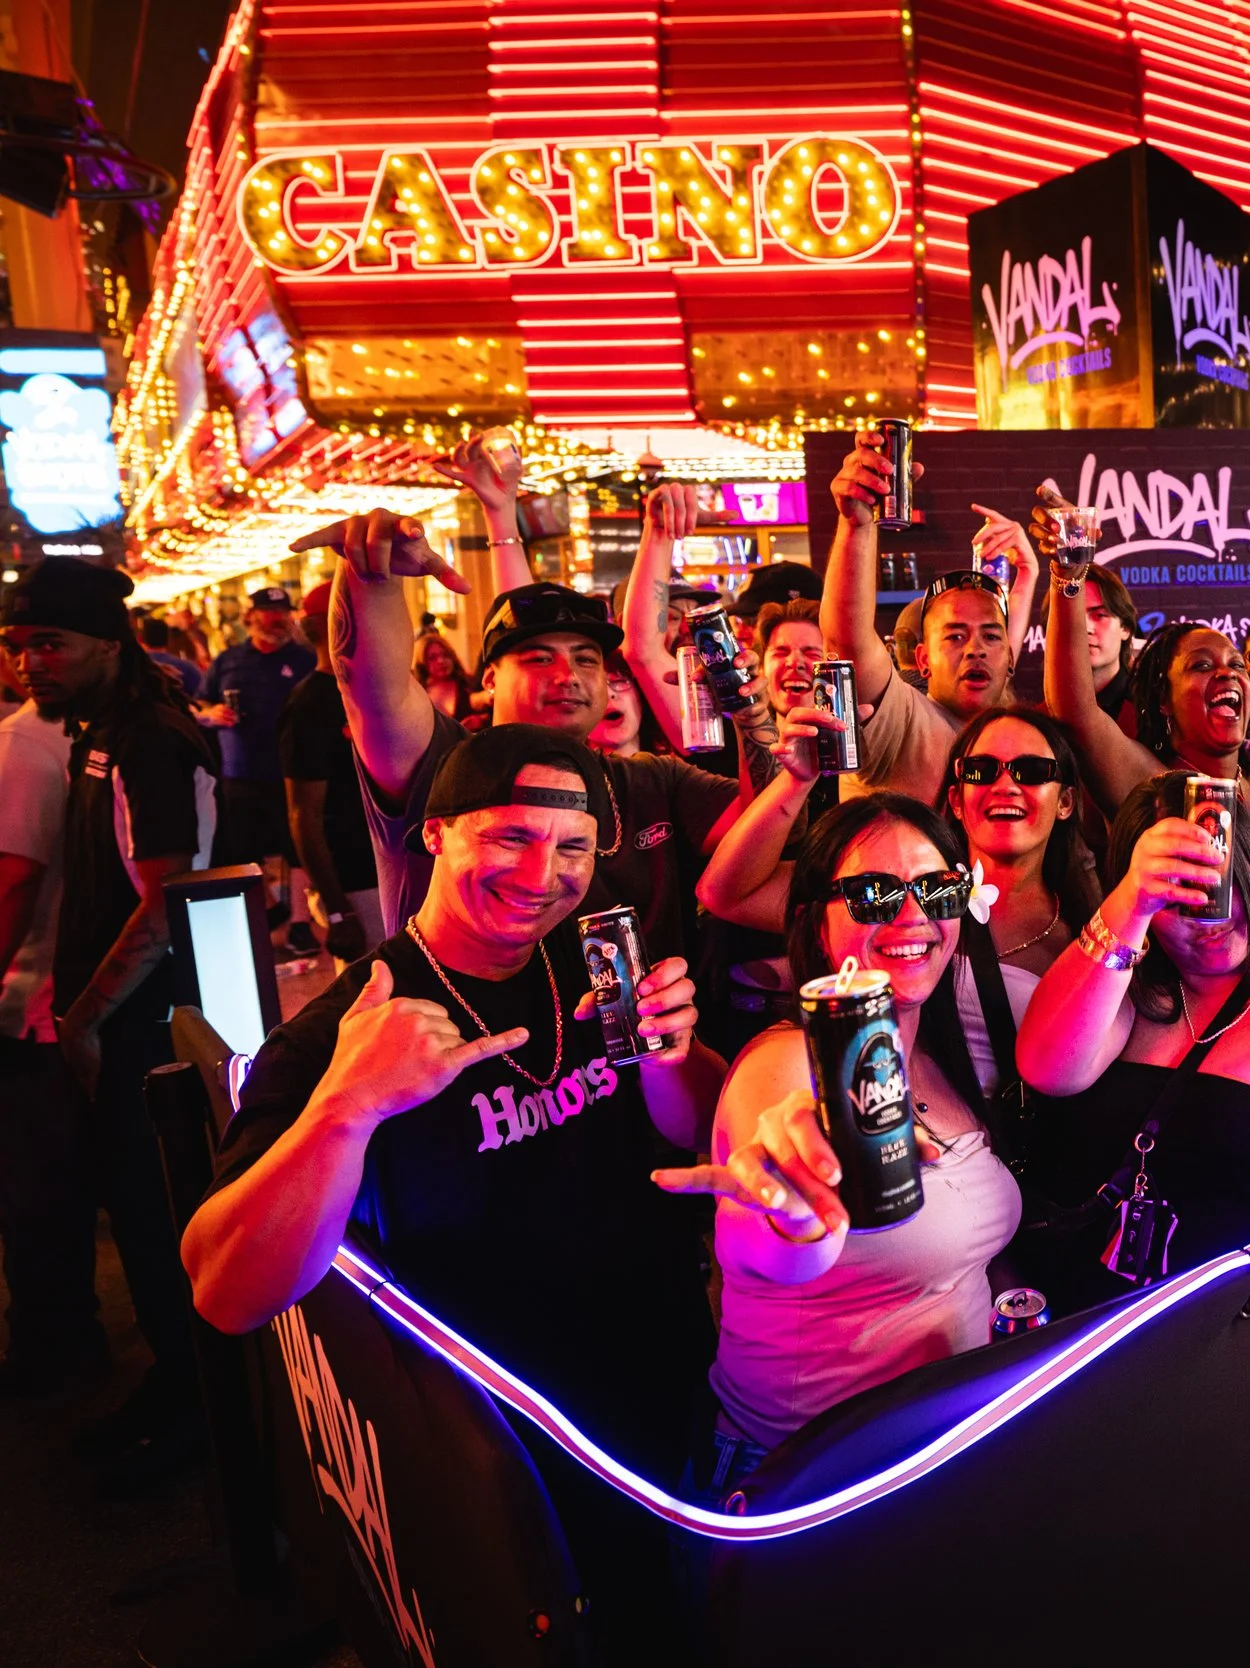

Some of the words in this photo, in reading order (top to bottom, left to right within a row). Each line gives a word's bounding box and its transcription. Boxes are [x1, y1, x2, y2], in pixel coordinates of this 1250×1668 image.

[236, 134, 903, 276] CASINO
[980, 235, 1122, 385] VANDAL
[1120, 566, 1171, 585] VODKA
[639, 826, 668, 847] Ford
[471, 1056, 618, 1153] Honors
